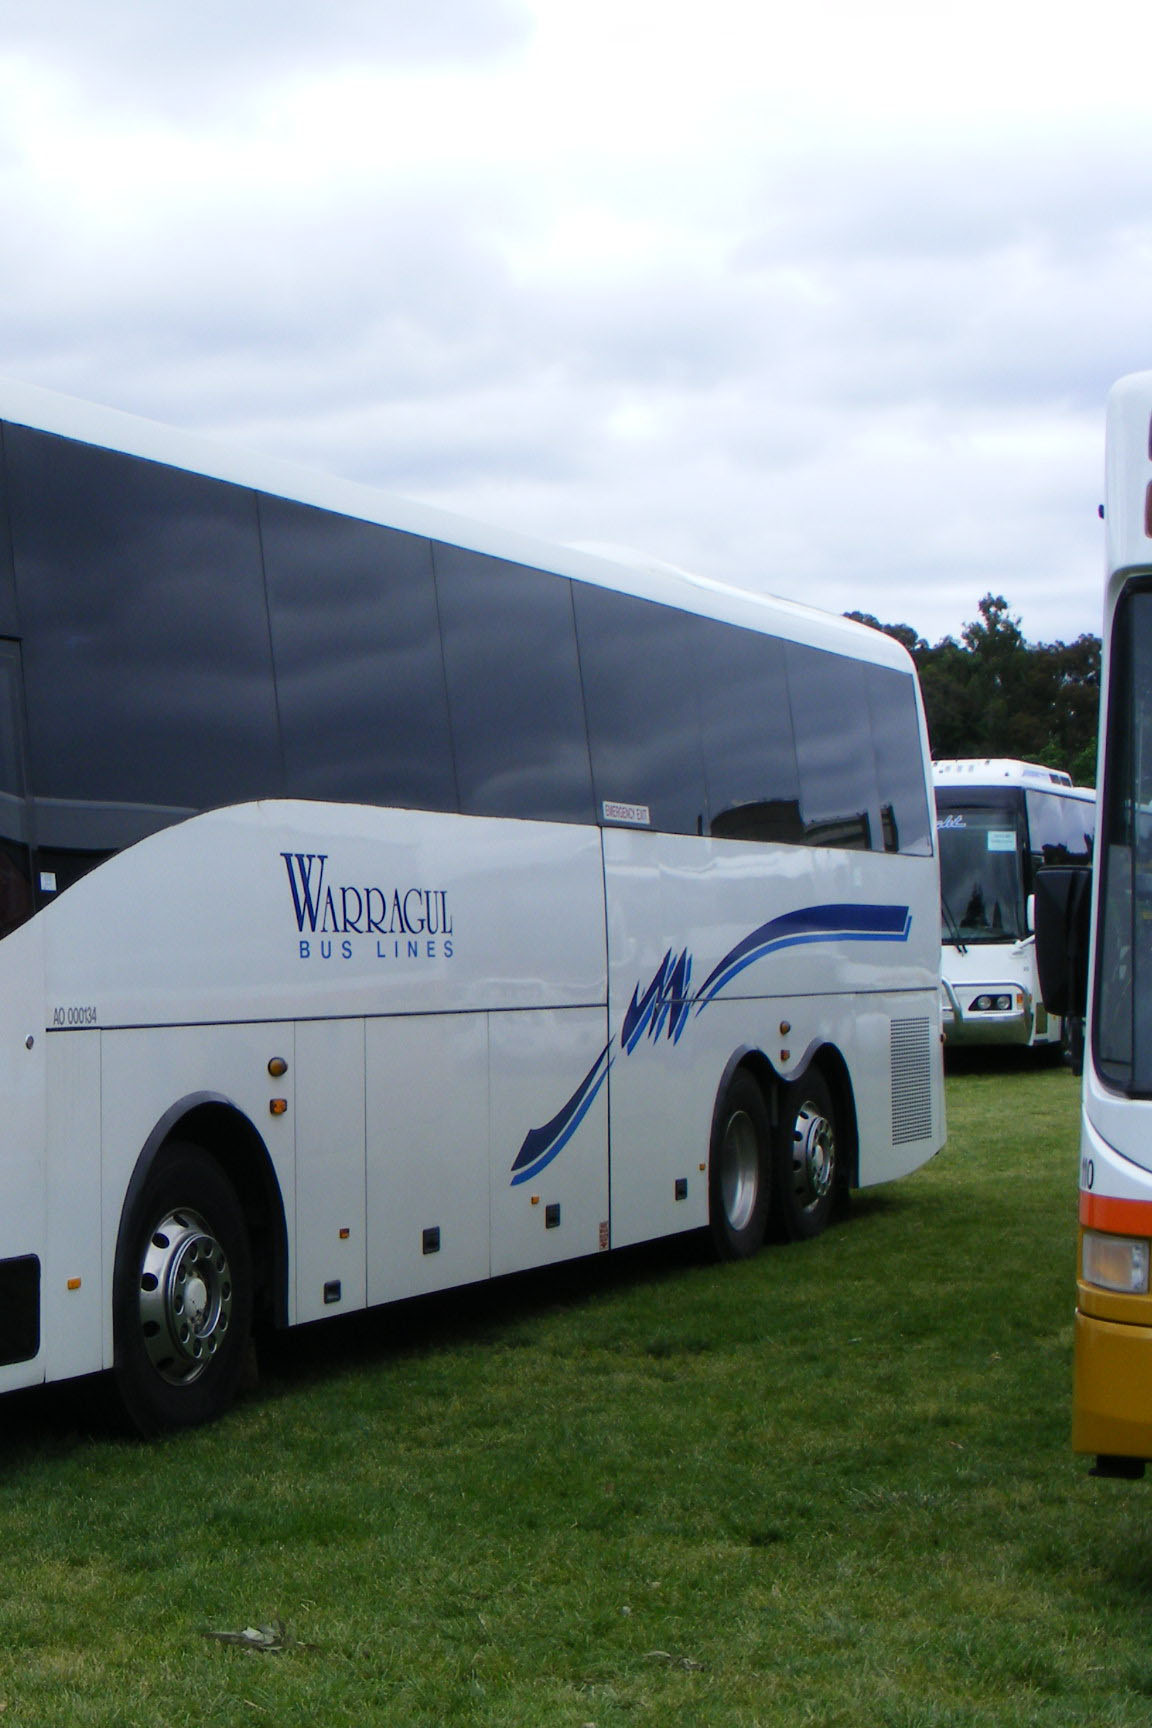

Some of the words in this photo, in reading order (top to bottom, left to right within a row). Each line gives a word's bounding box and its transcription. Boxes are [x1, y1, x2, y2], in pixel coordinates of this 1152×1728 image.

[280, 852, 453, 935] WARRAGUL
[299, 940, 352, 959] BUS
[377, 940, 453, 958] LINES
[67, 1006, 97, 1025] 000134
